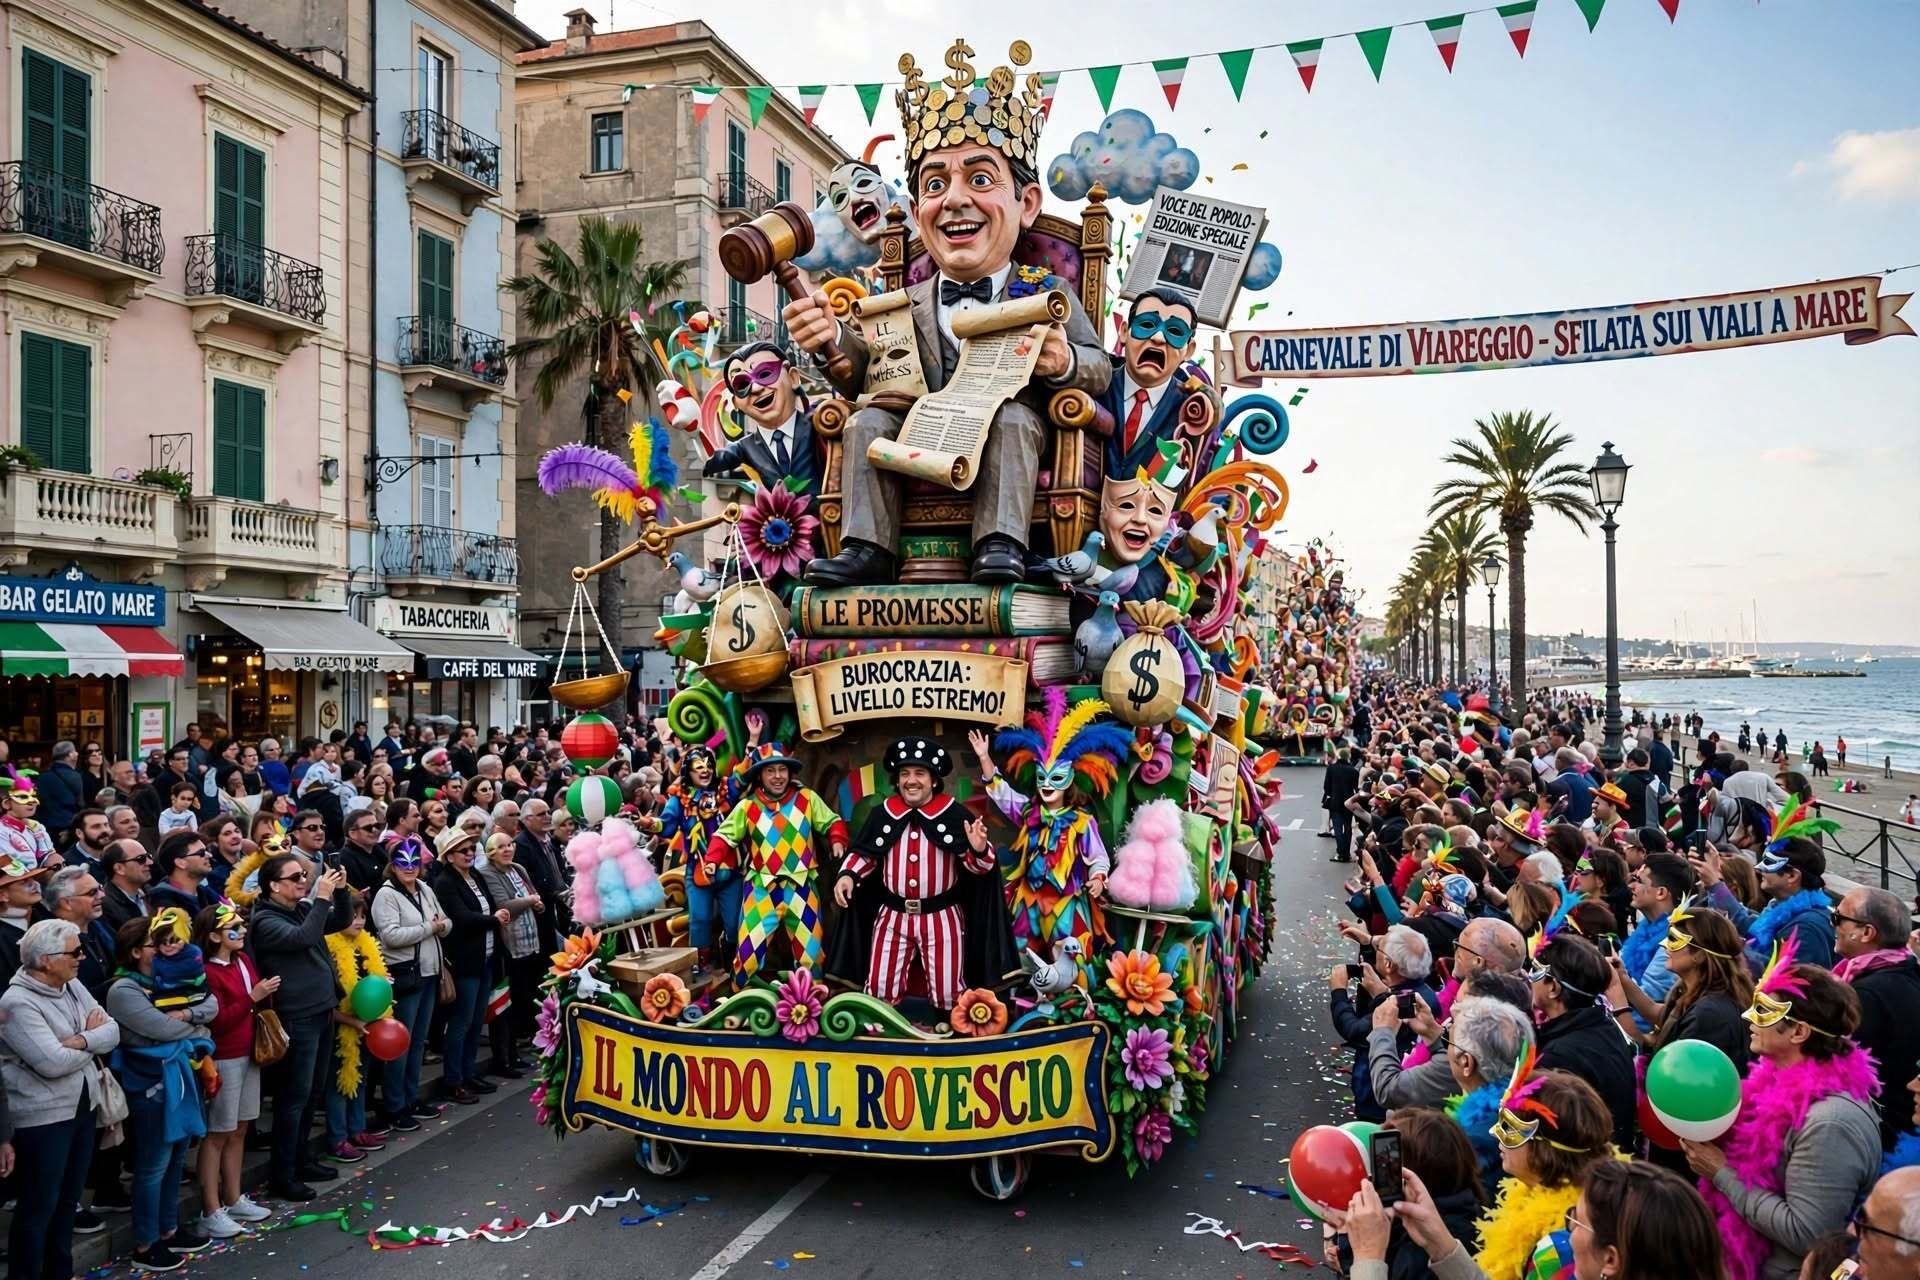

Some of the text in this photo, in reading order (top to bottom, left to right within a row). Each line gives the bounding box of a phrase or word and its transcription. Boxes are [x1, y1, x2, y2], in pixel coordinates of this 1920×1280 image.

[1160, 194, 1188, 216] VOCE
[1188, 201, 1207, 220] DEL
[1153, 214, 1249, 250] EDIZIONE SPECIALE
[1244, 334, 1372, 372] CARNEVALE
[1379, 333, 1402, 368] DI
[1406, 324, 1533, 366] VIAREGGIO
[1553, 314, 1645, 357] SFILATA
[1653, 309, 1692, 348] SUI
[1697, 301, 1764, 342] VIALI
[1770, 298, 1790, 333] A
[1793, 286, 1868, 331] MARE
[0, 585, 155, 617] BAR GELATO MARE
[820, 598, 984, 627] LE PROMESSE
[400, 605, 490, 631] TABACCHERIA
[483, 661, 505, 677] DEL
[507, 662, 537, 677] MARE
[842, 659, 972, 688] BUROCRAZIA:
[831, 686, 1006, 716] LIVELLO ESTREMO!
[594, 1034, 1073, 1131] IL MONDO AL ROVESCIO
